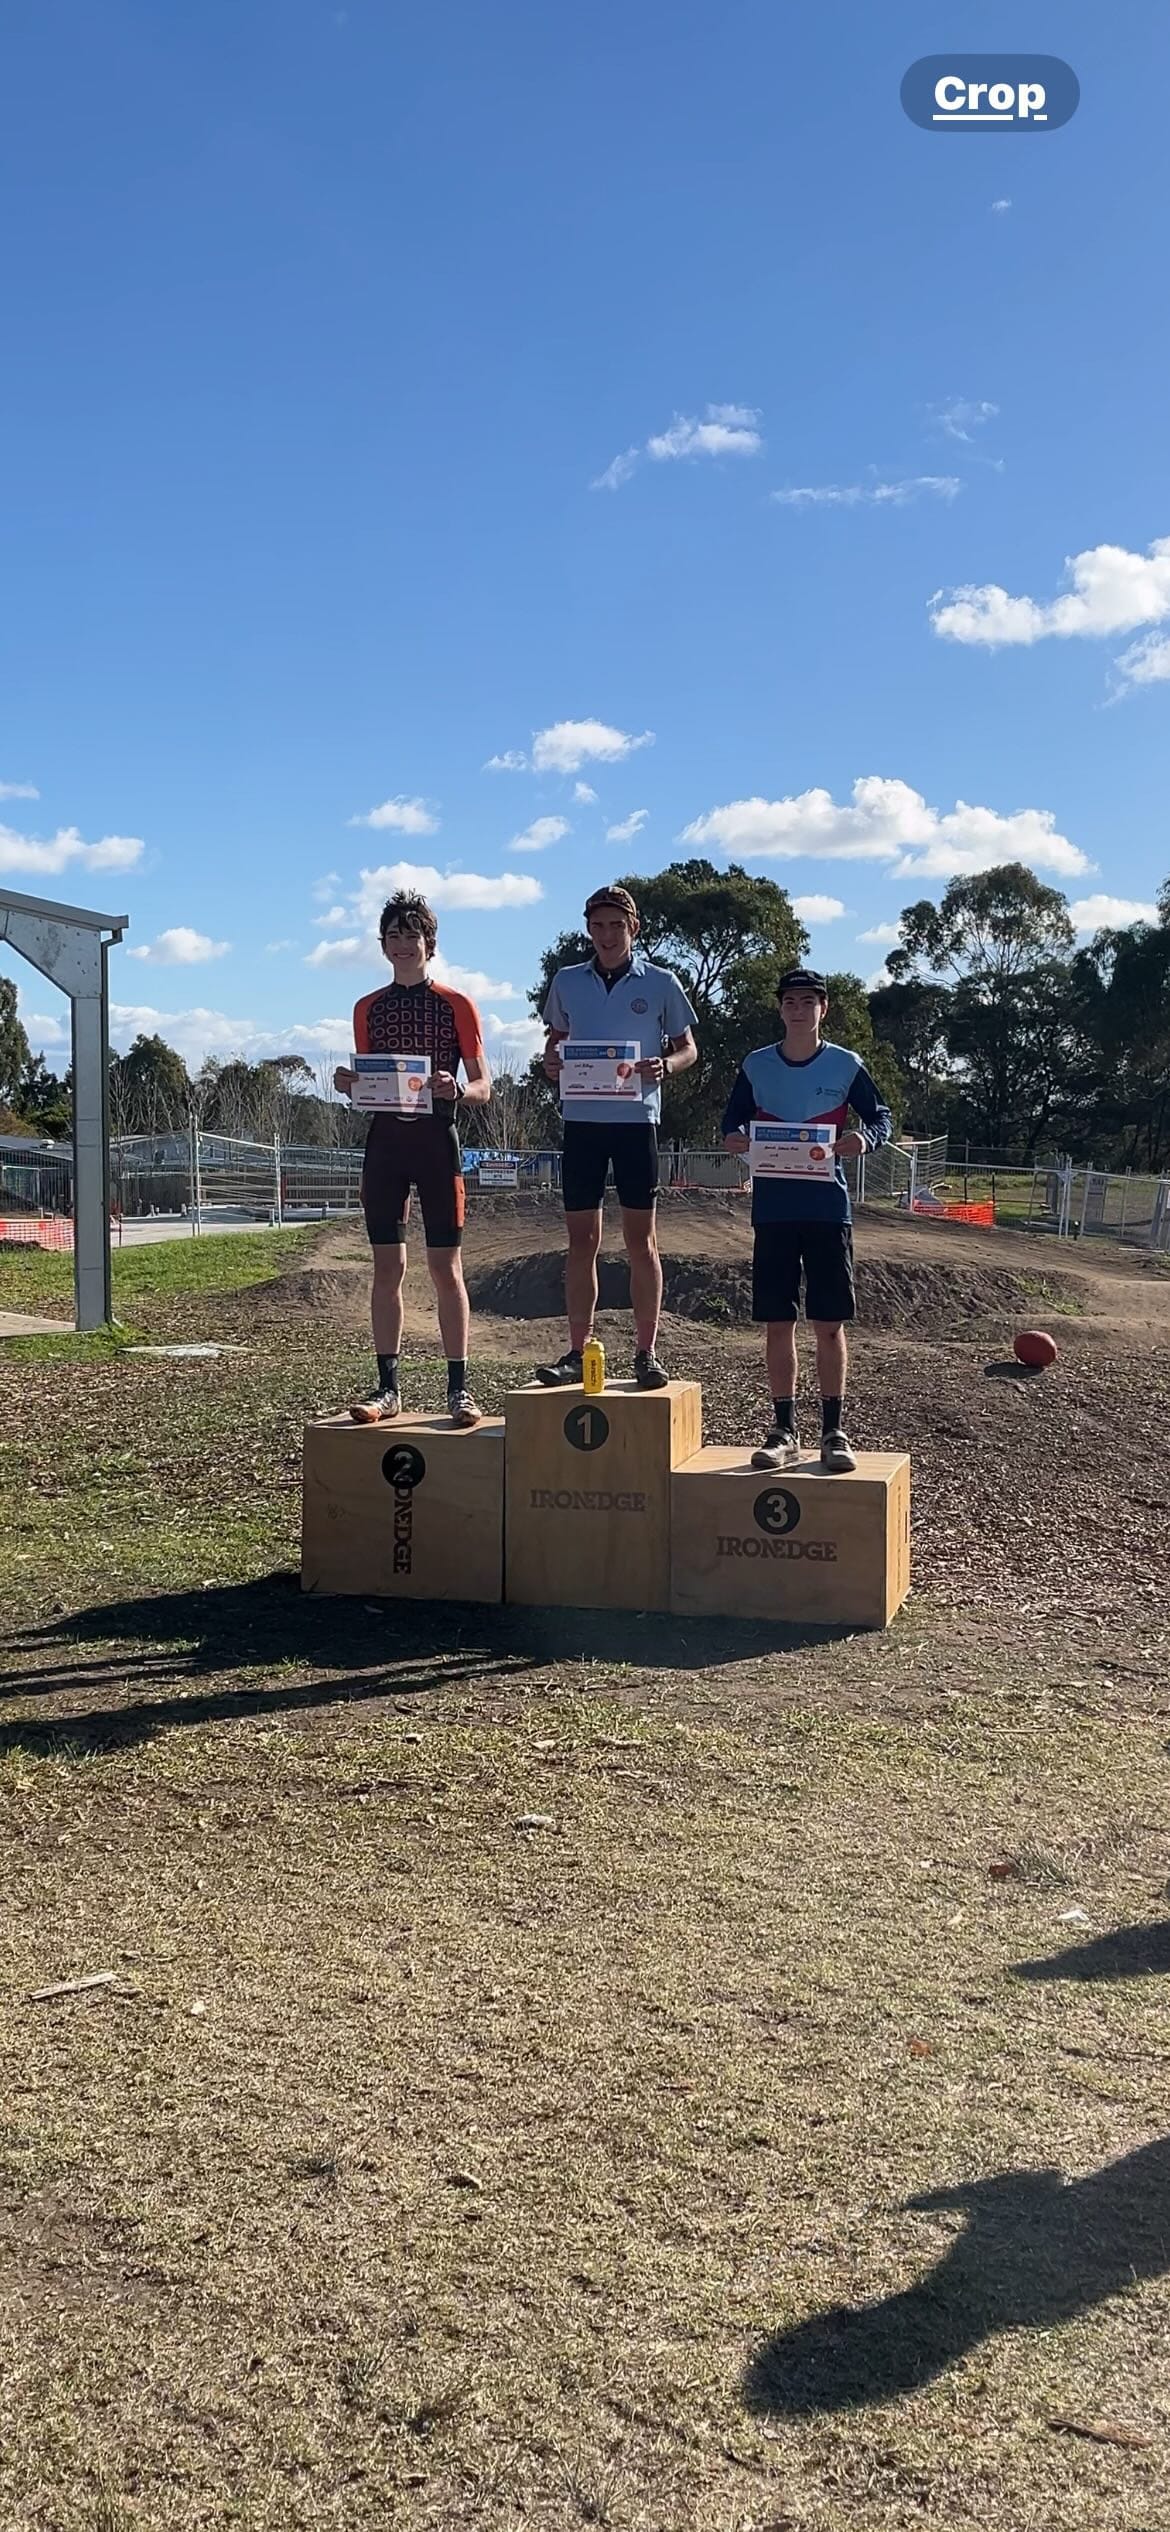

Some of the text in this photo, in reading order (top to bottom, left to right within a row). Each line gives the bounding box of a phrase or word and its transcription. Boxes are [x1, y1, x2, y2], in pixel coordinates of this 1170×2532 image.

[371, 998, 453, 1014] OODLEIG
[371, 1010, 453, 1026] OODLEIG
[371, 1023, 456, 1039] OODLEIG
[576, 1411, 592, 1444] 1
[392, 1450, 414, 1483] 2
[529, 1489, 647, 1512] IRONEDGE
[765, 1494, 789, 1529] 3
[392, 1487, 413, 1575] ONEDGE
[716, 1535, 838, 1562] IRONEDGE
